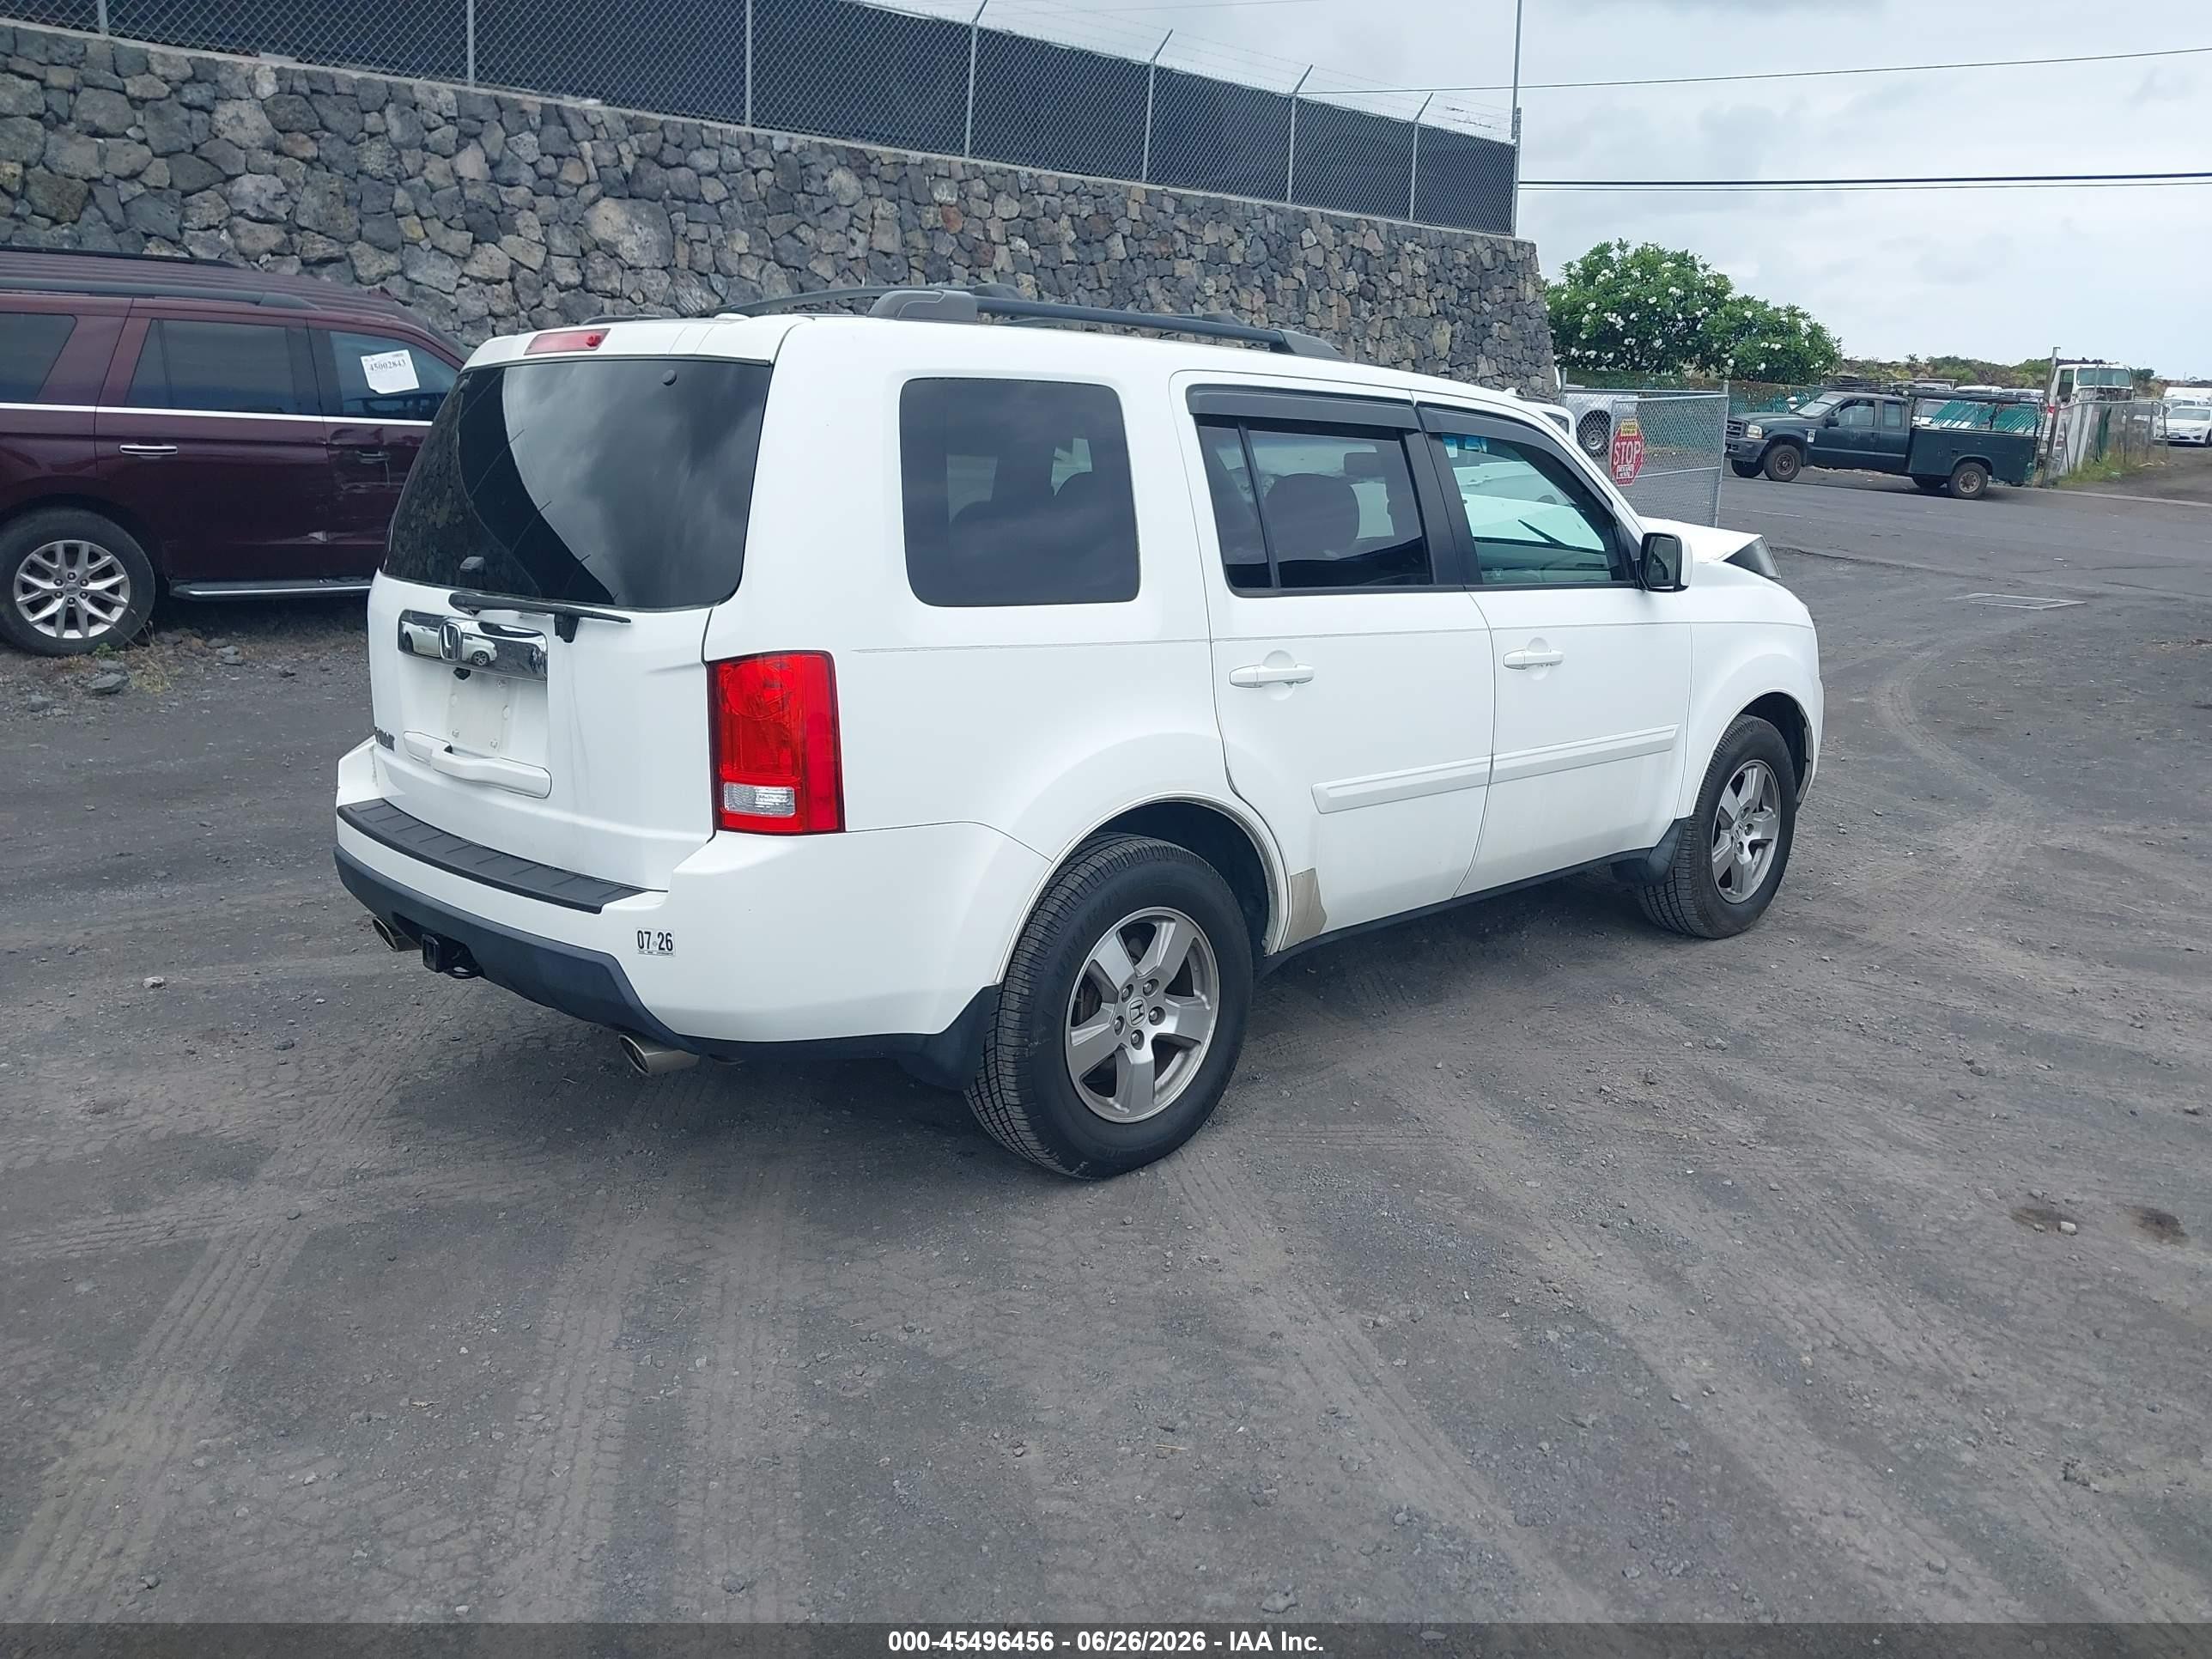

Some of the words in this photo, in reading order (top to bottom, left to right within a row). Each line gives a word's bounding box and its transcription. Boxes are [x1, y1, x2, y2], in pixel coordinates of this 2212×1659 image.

[1614, 441, 1641, 465] STOP
[637, 930, 651, 950] 07
[658, 932, 673, 951] 26
